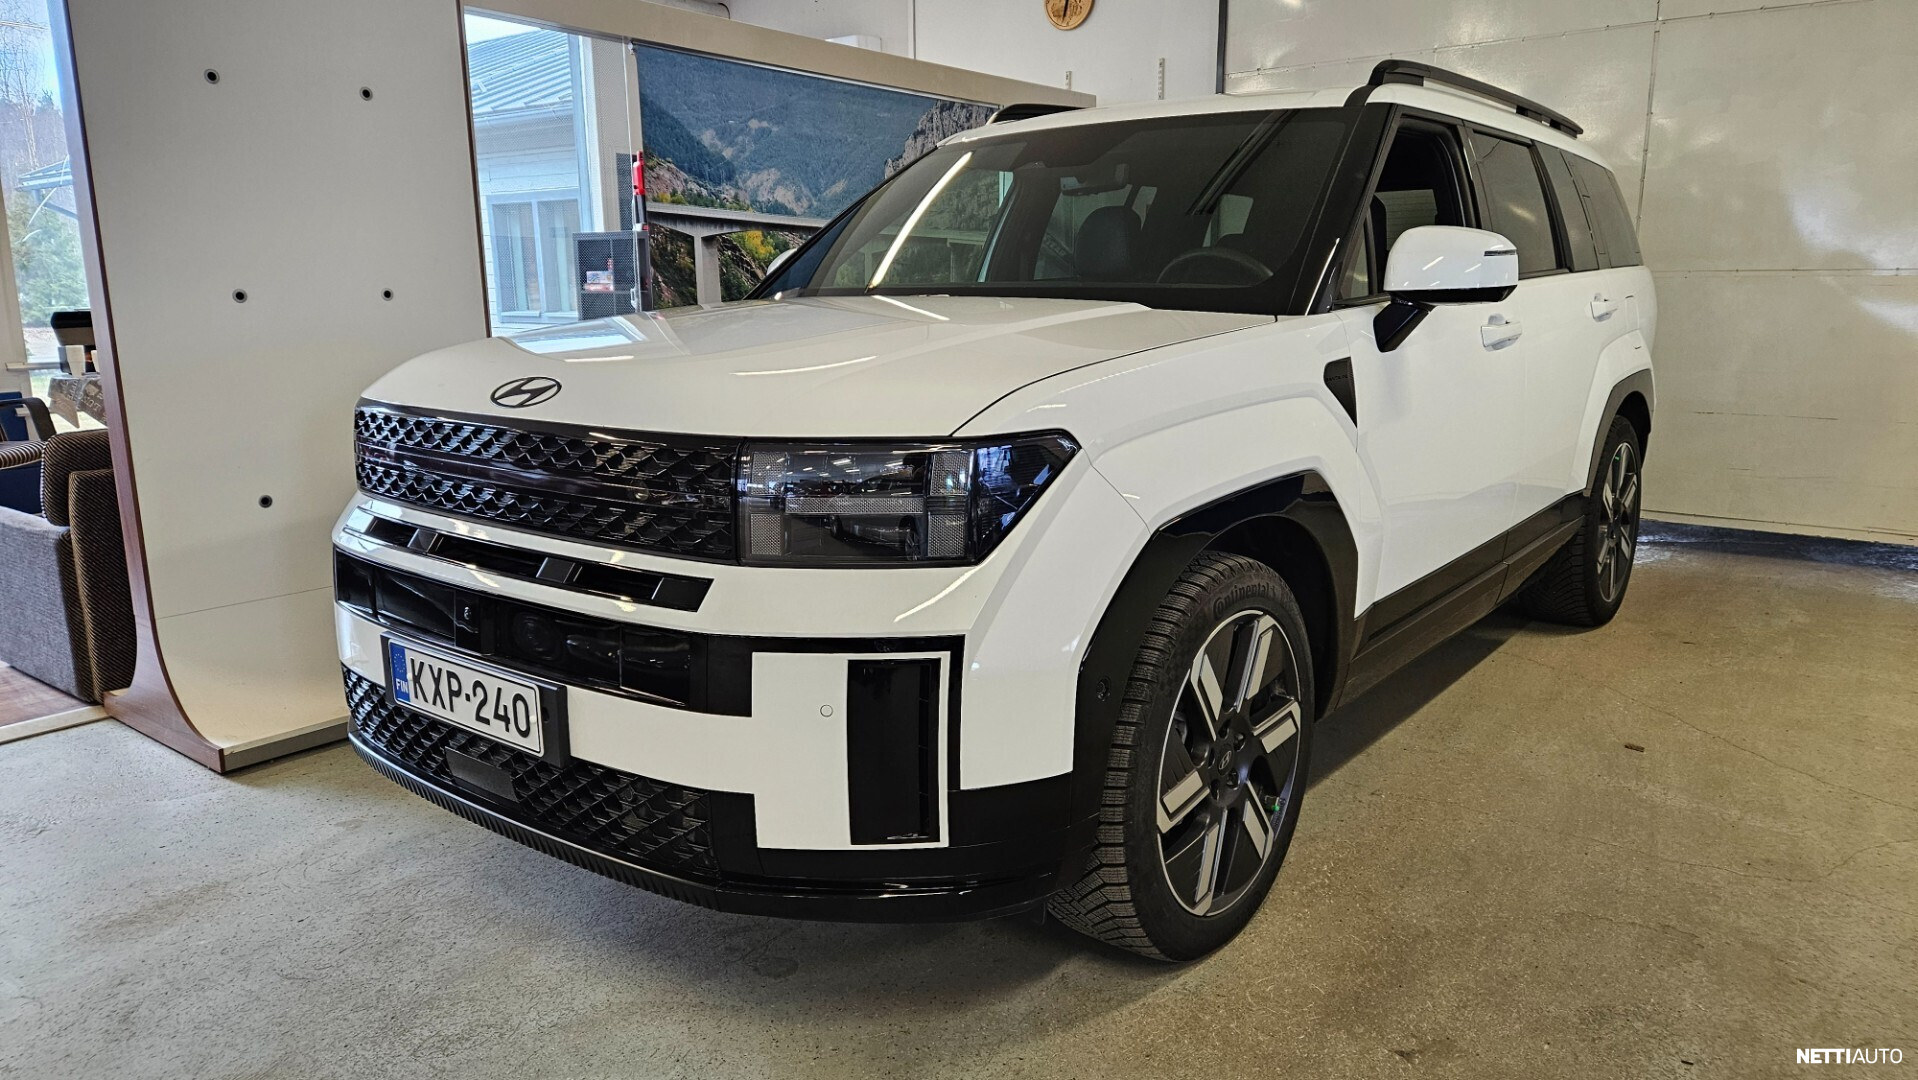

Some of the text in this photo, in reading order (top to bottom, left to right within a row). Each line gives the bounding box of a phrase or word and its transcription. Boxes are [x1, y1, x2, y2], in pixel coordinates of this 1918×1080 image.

[1213, 582, 1269, 619] Continental
[395, 678, 409, 693] FIN
[410, 658, 531, 738] KXP-240
